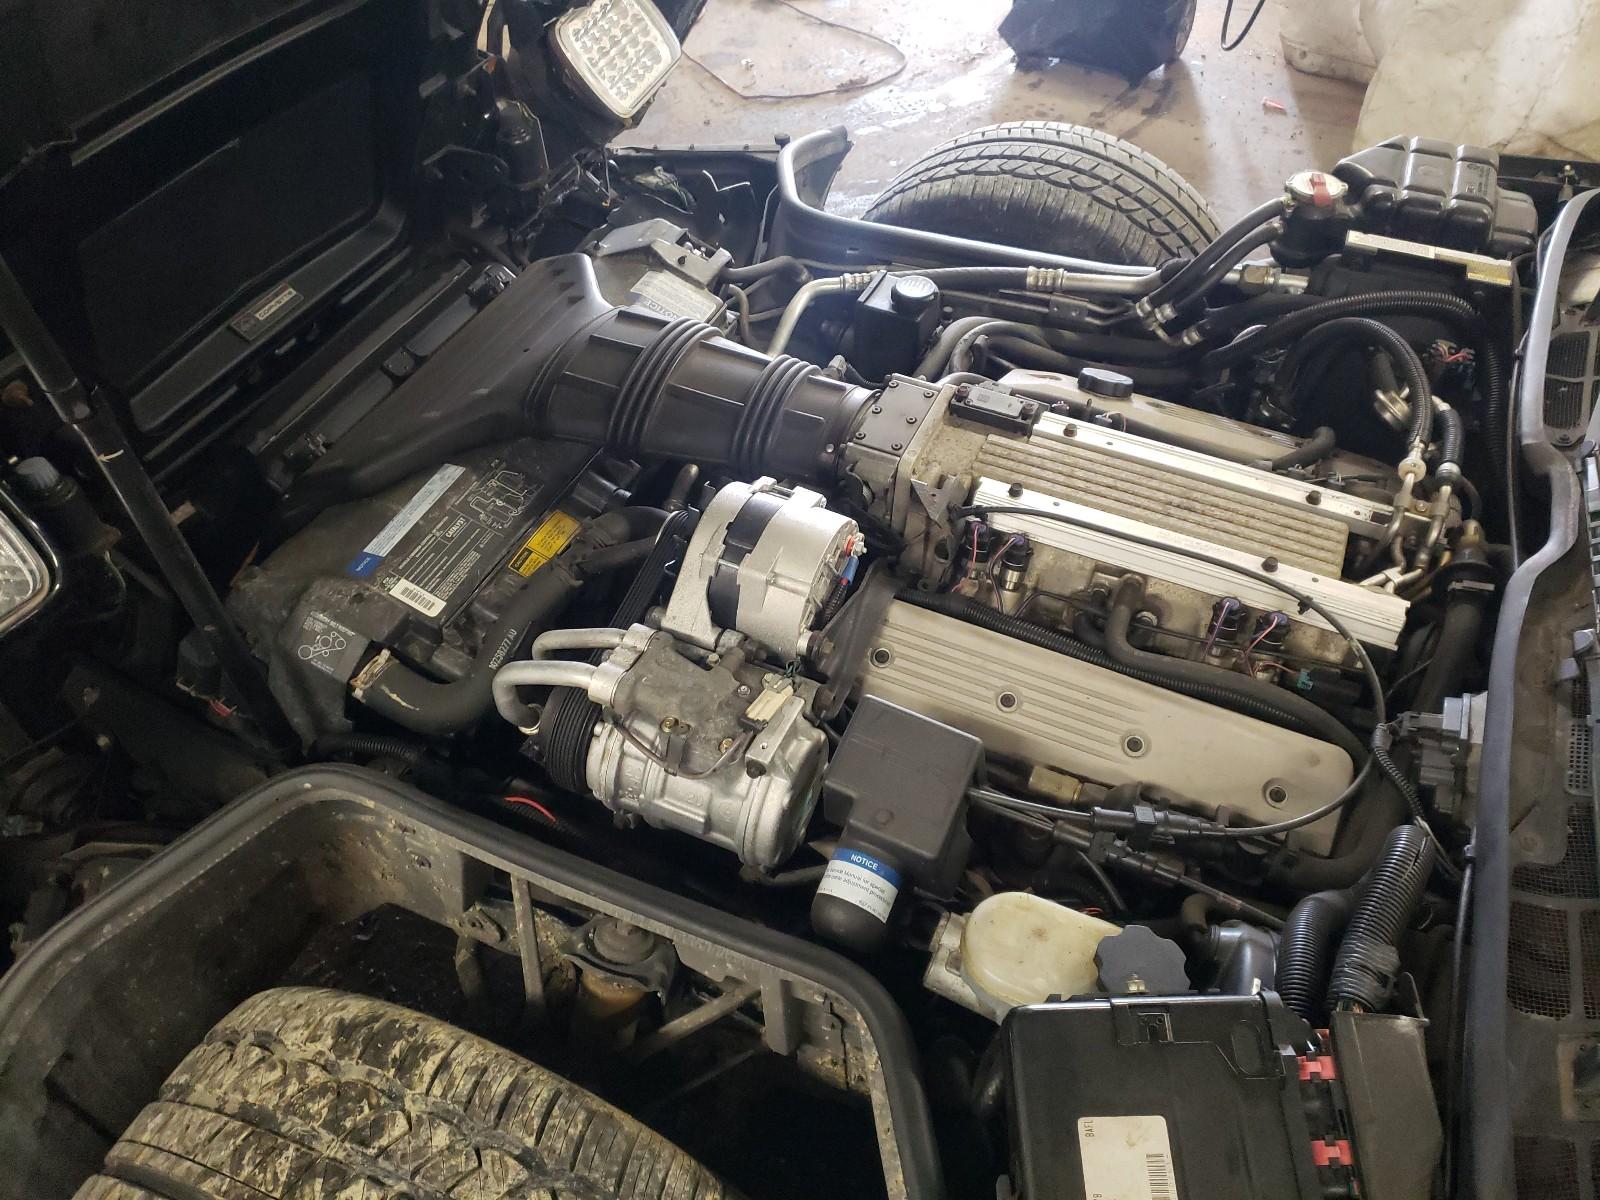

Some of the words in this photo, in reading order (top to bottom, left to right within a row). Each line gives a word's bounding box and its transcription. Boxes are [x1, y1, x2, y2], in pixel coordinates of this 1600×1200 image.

[445, 517, 466, 538] CATALYST
[850, 853, 879, 870] NOTICE
[1083, 1120, 1095, 1138] BAFL
